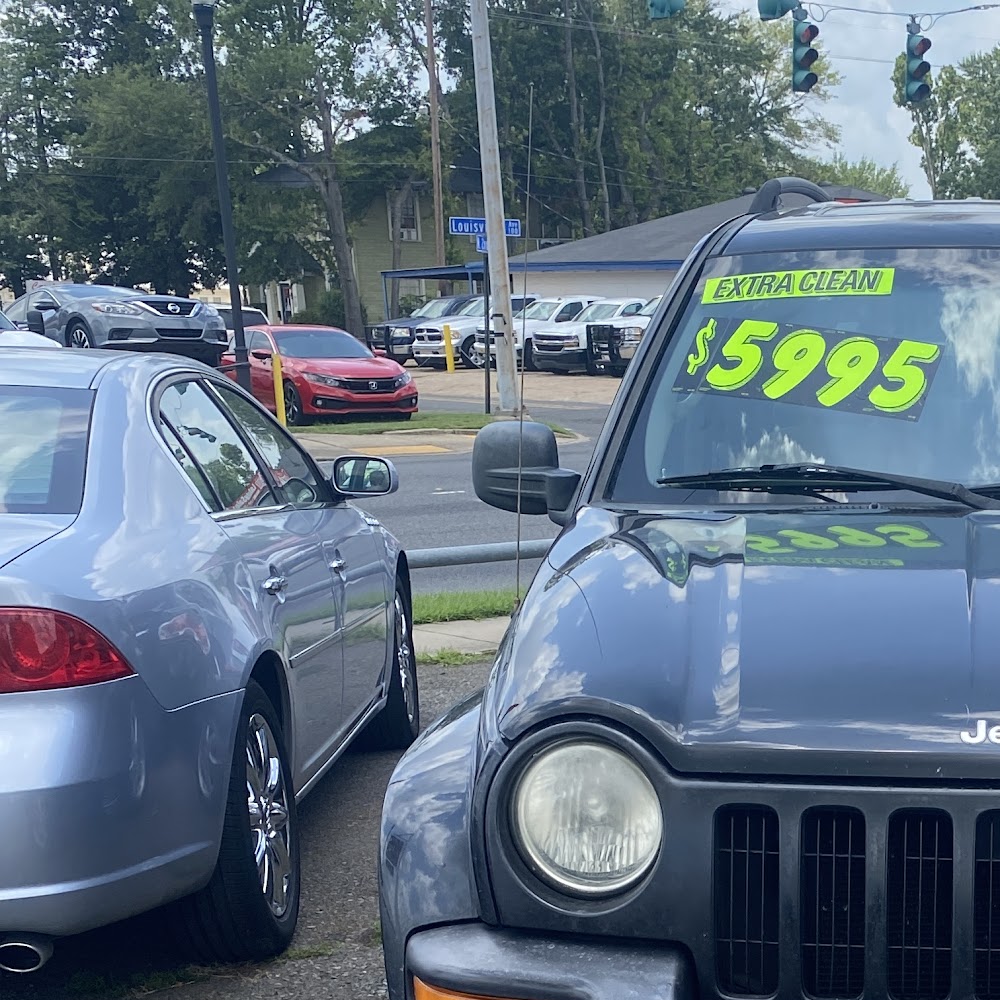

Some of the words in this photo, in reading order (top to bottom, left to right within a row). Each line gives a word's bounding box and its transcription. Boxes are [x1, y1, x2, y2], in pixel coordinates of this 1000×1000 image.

[452, 219, 485, 233] Louisv
[712, 273, 796, 299] EXTRA
[800, 269, 884, 293] CLEAN
[687, 318, 940, 413] $5995
